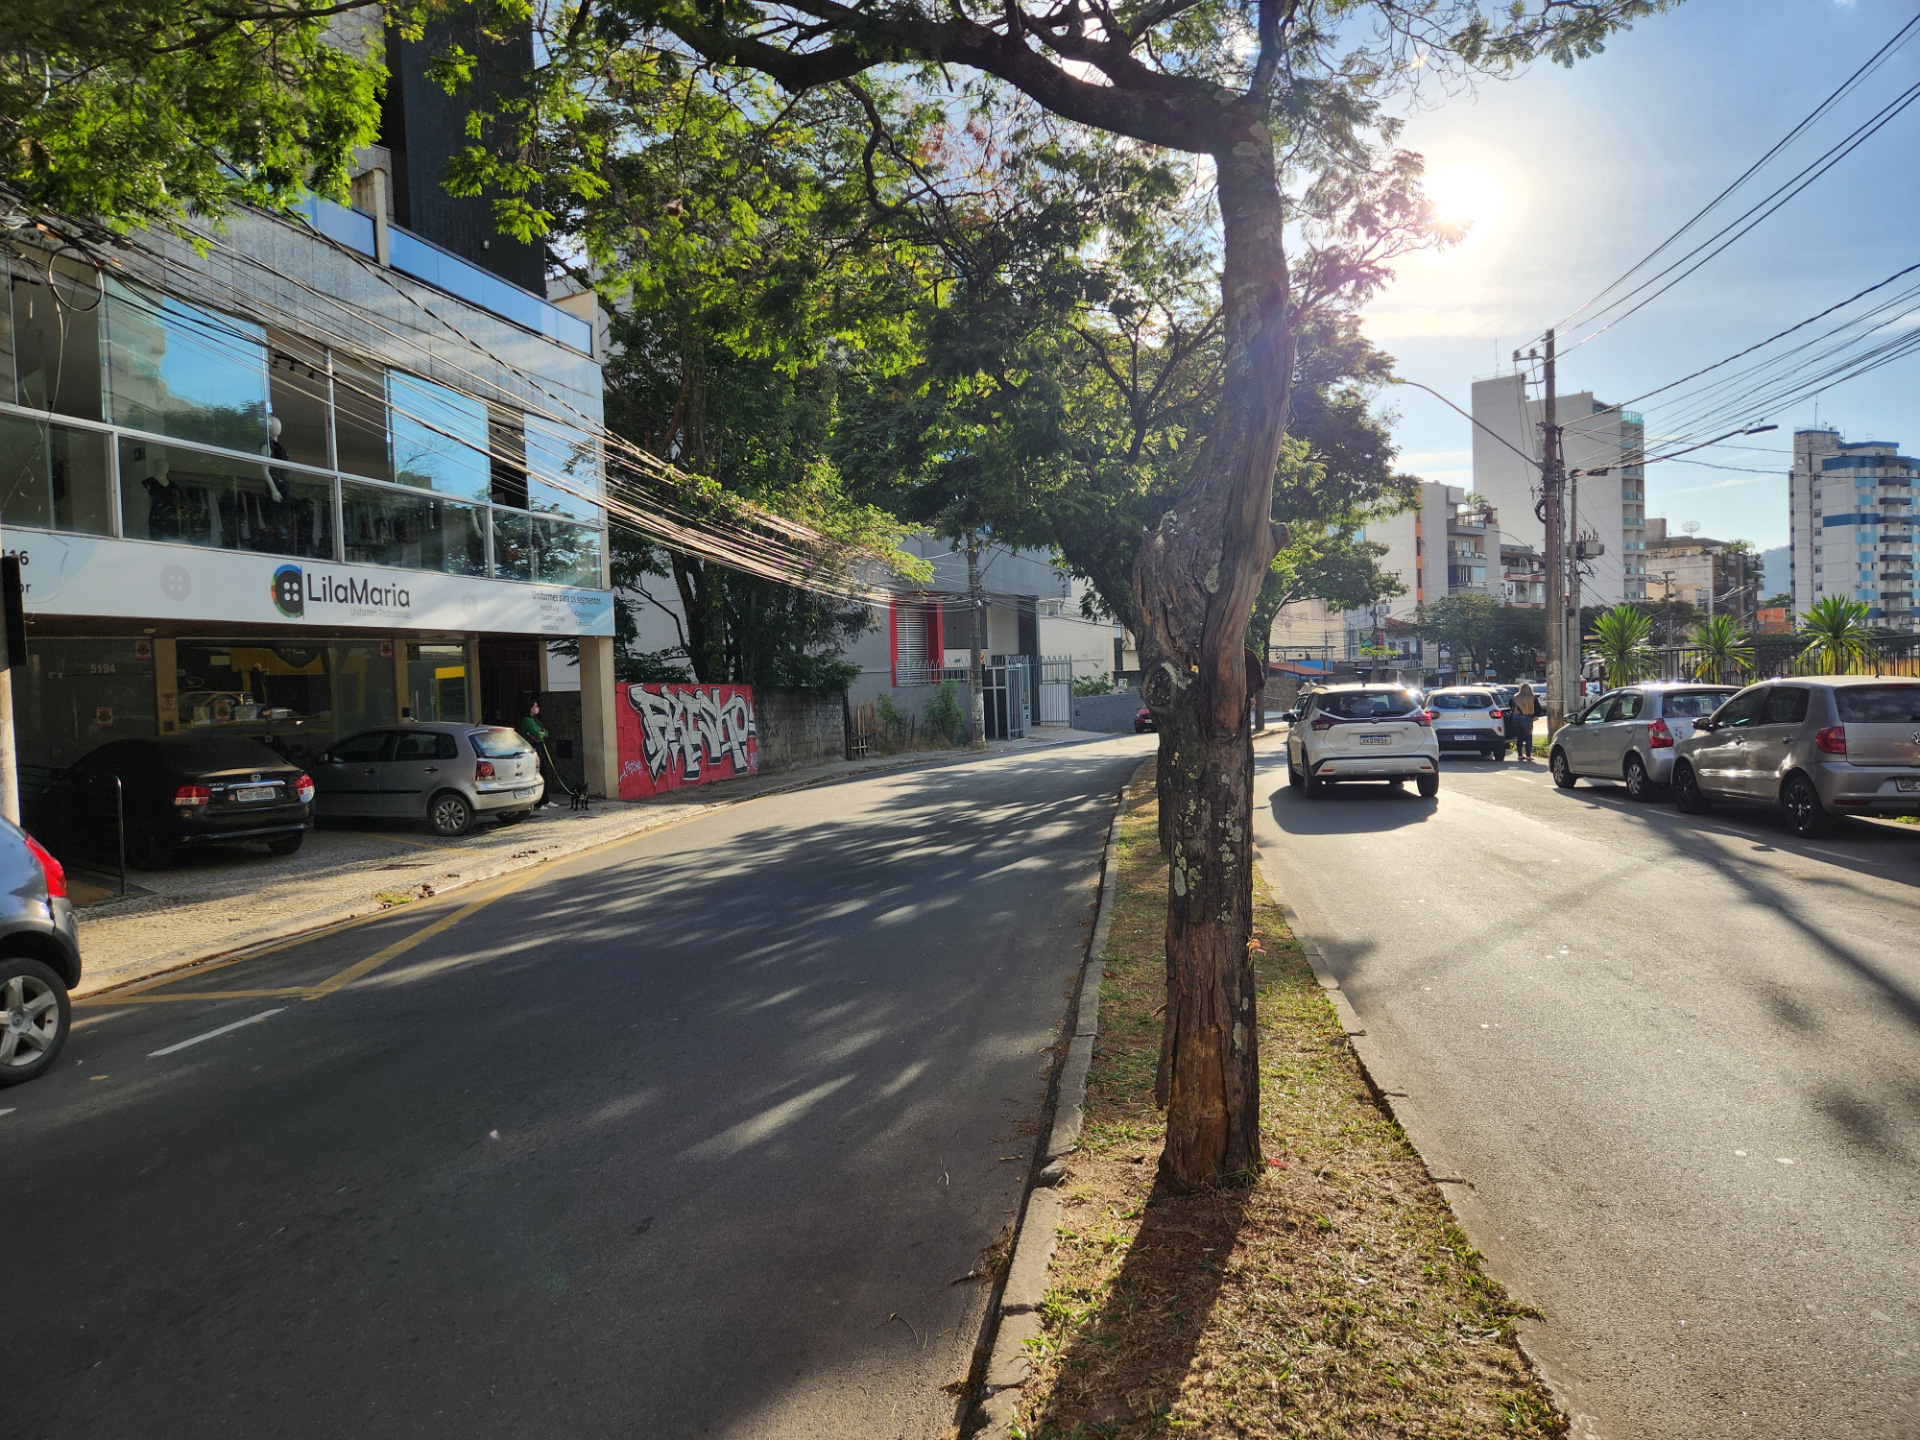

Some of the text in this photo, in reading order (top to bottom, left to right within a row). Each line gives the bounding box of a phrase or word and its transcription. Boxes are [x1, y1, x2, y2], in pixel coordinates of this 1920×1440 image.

[306, 573, 410, 607] LilaMaria
[532, 590, 559, 601] Uniformes
[559, 594, 570, 603] para
[577, 596, 601, 605] segmentos
[350, 607, 411, 618] Uniformes Profissionais
[90, 663, 116, 674] 5194
